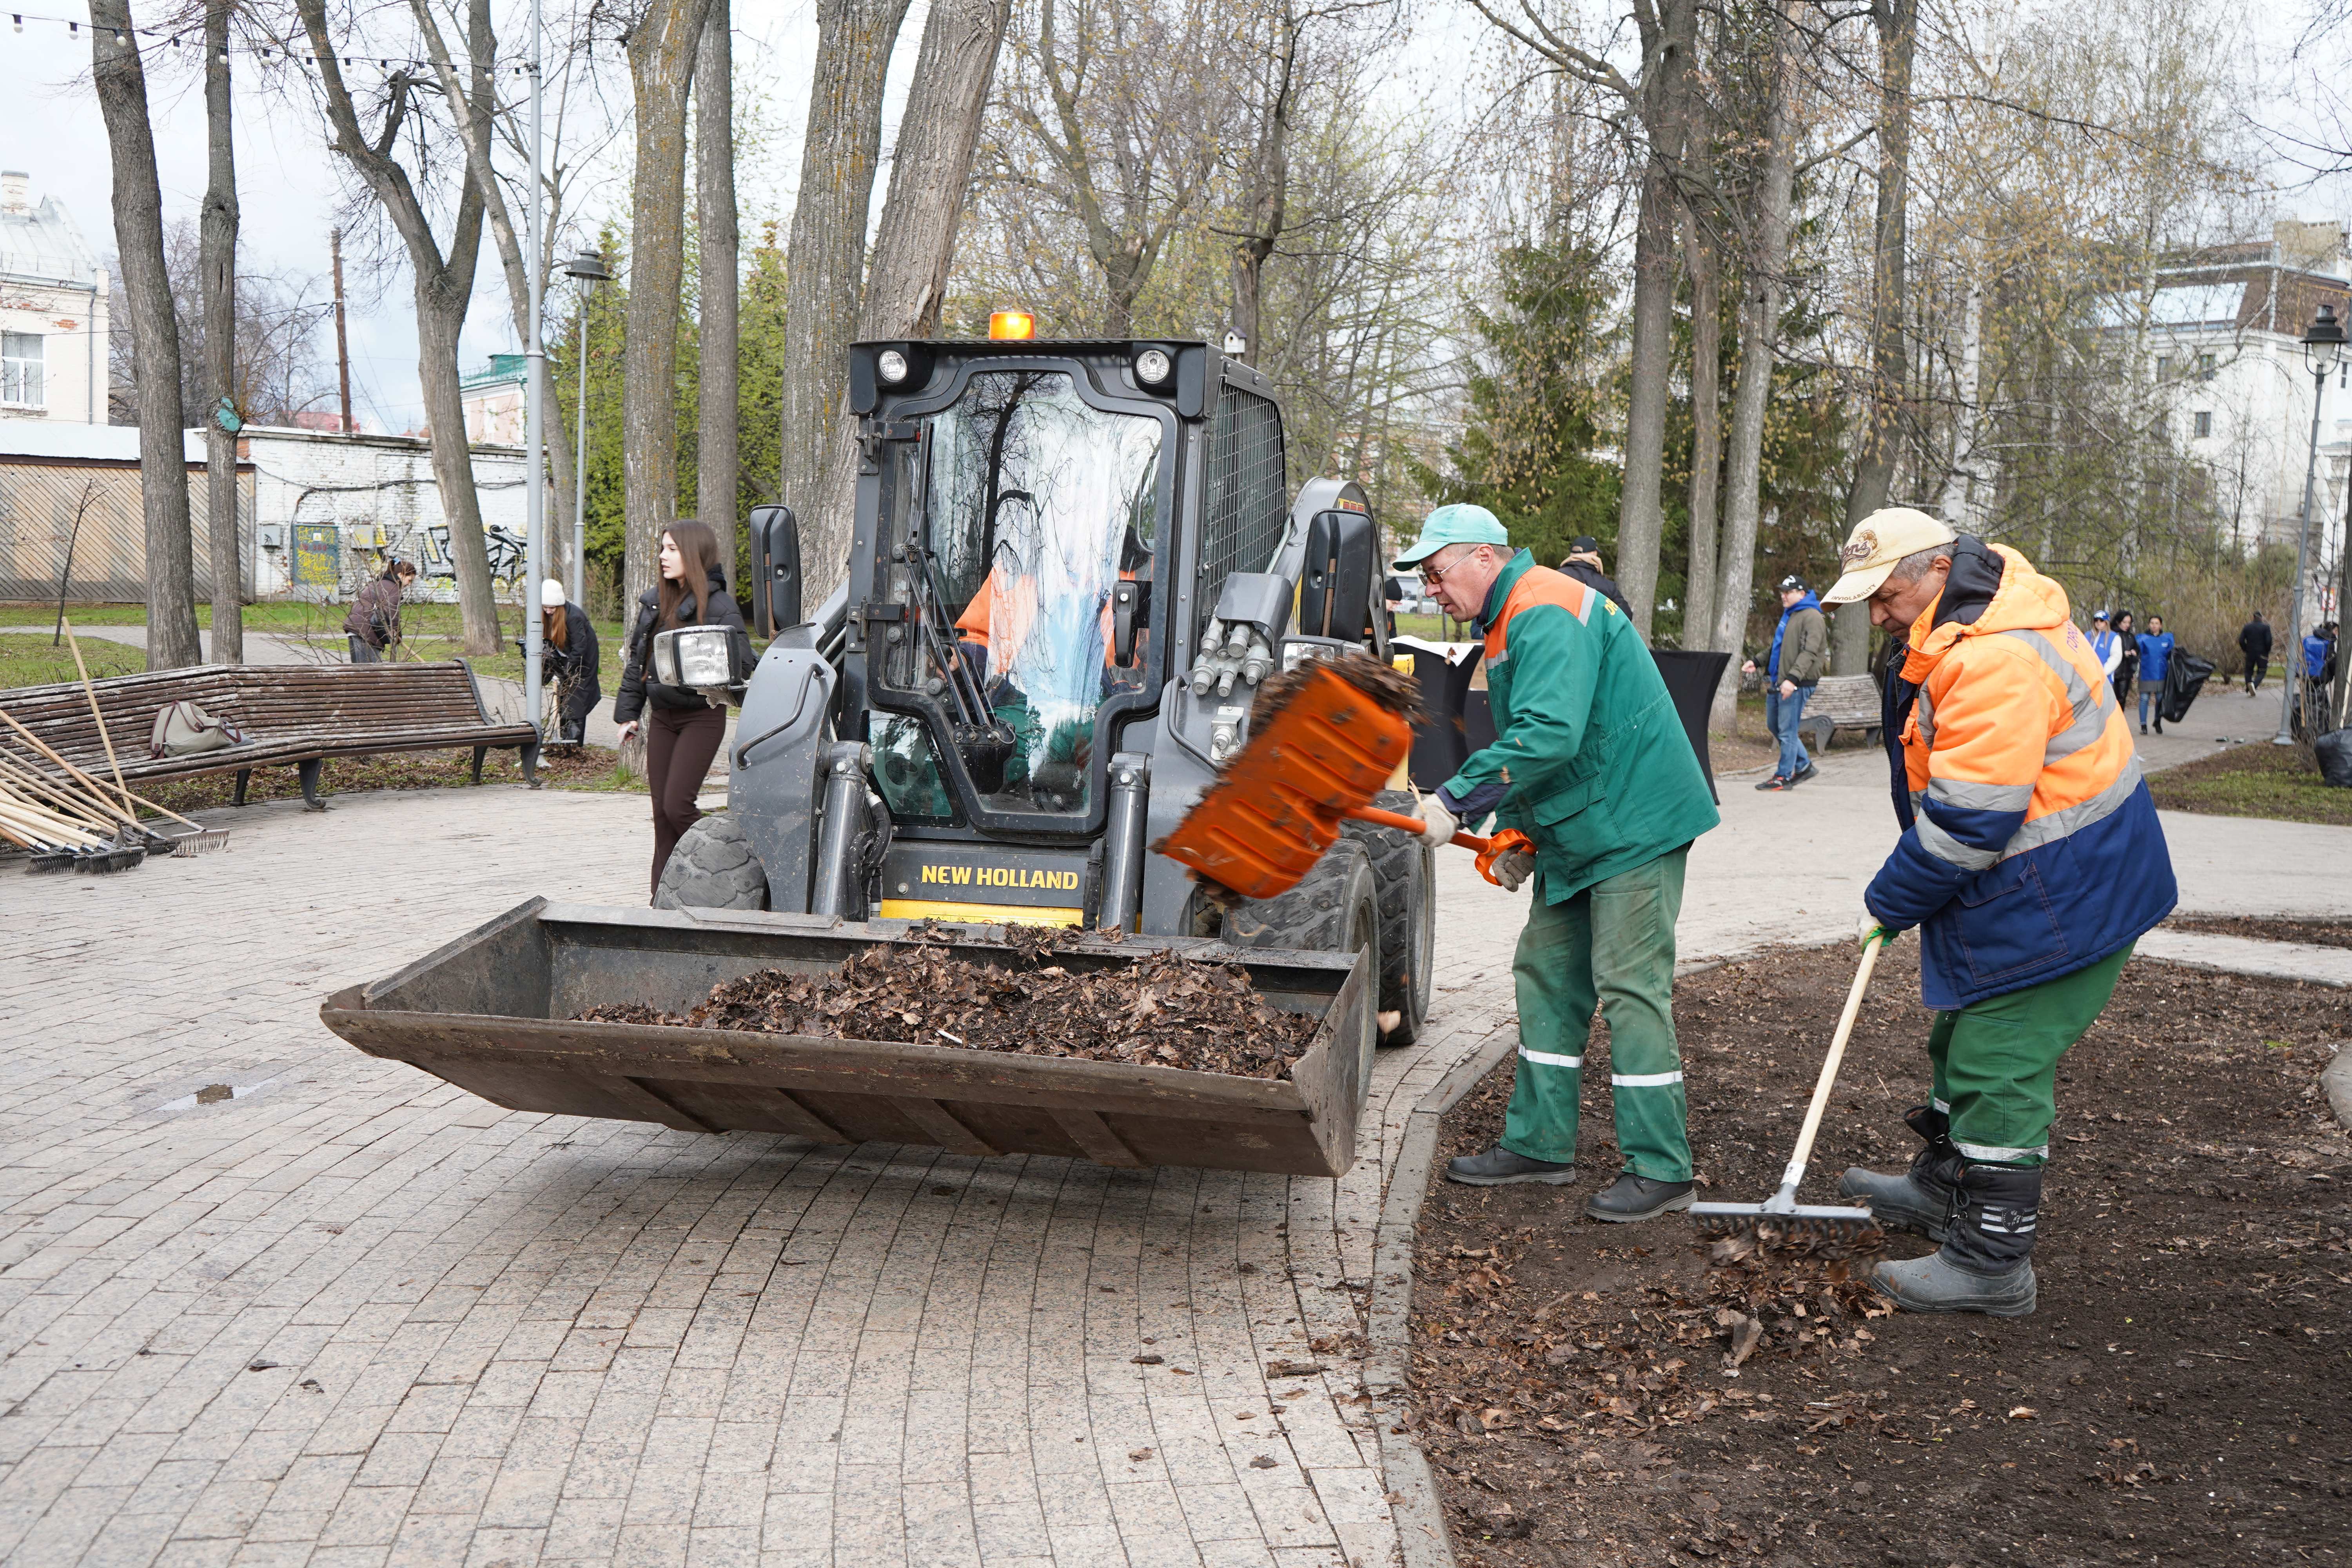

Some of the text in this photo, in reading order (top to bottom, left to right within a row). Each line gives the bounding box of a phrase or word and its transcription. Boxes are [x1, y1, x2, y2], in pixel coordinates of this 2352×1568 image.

[1831, 583, 1876, 601] INVIOLABILITY
[922, 865, 1079, 890] NEW HOLLAND
